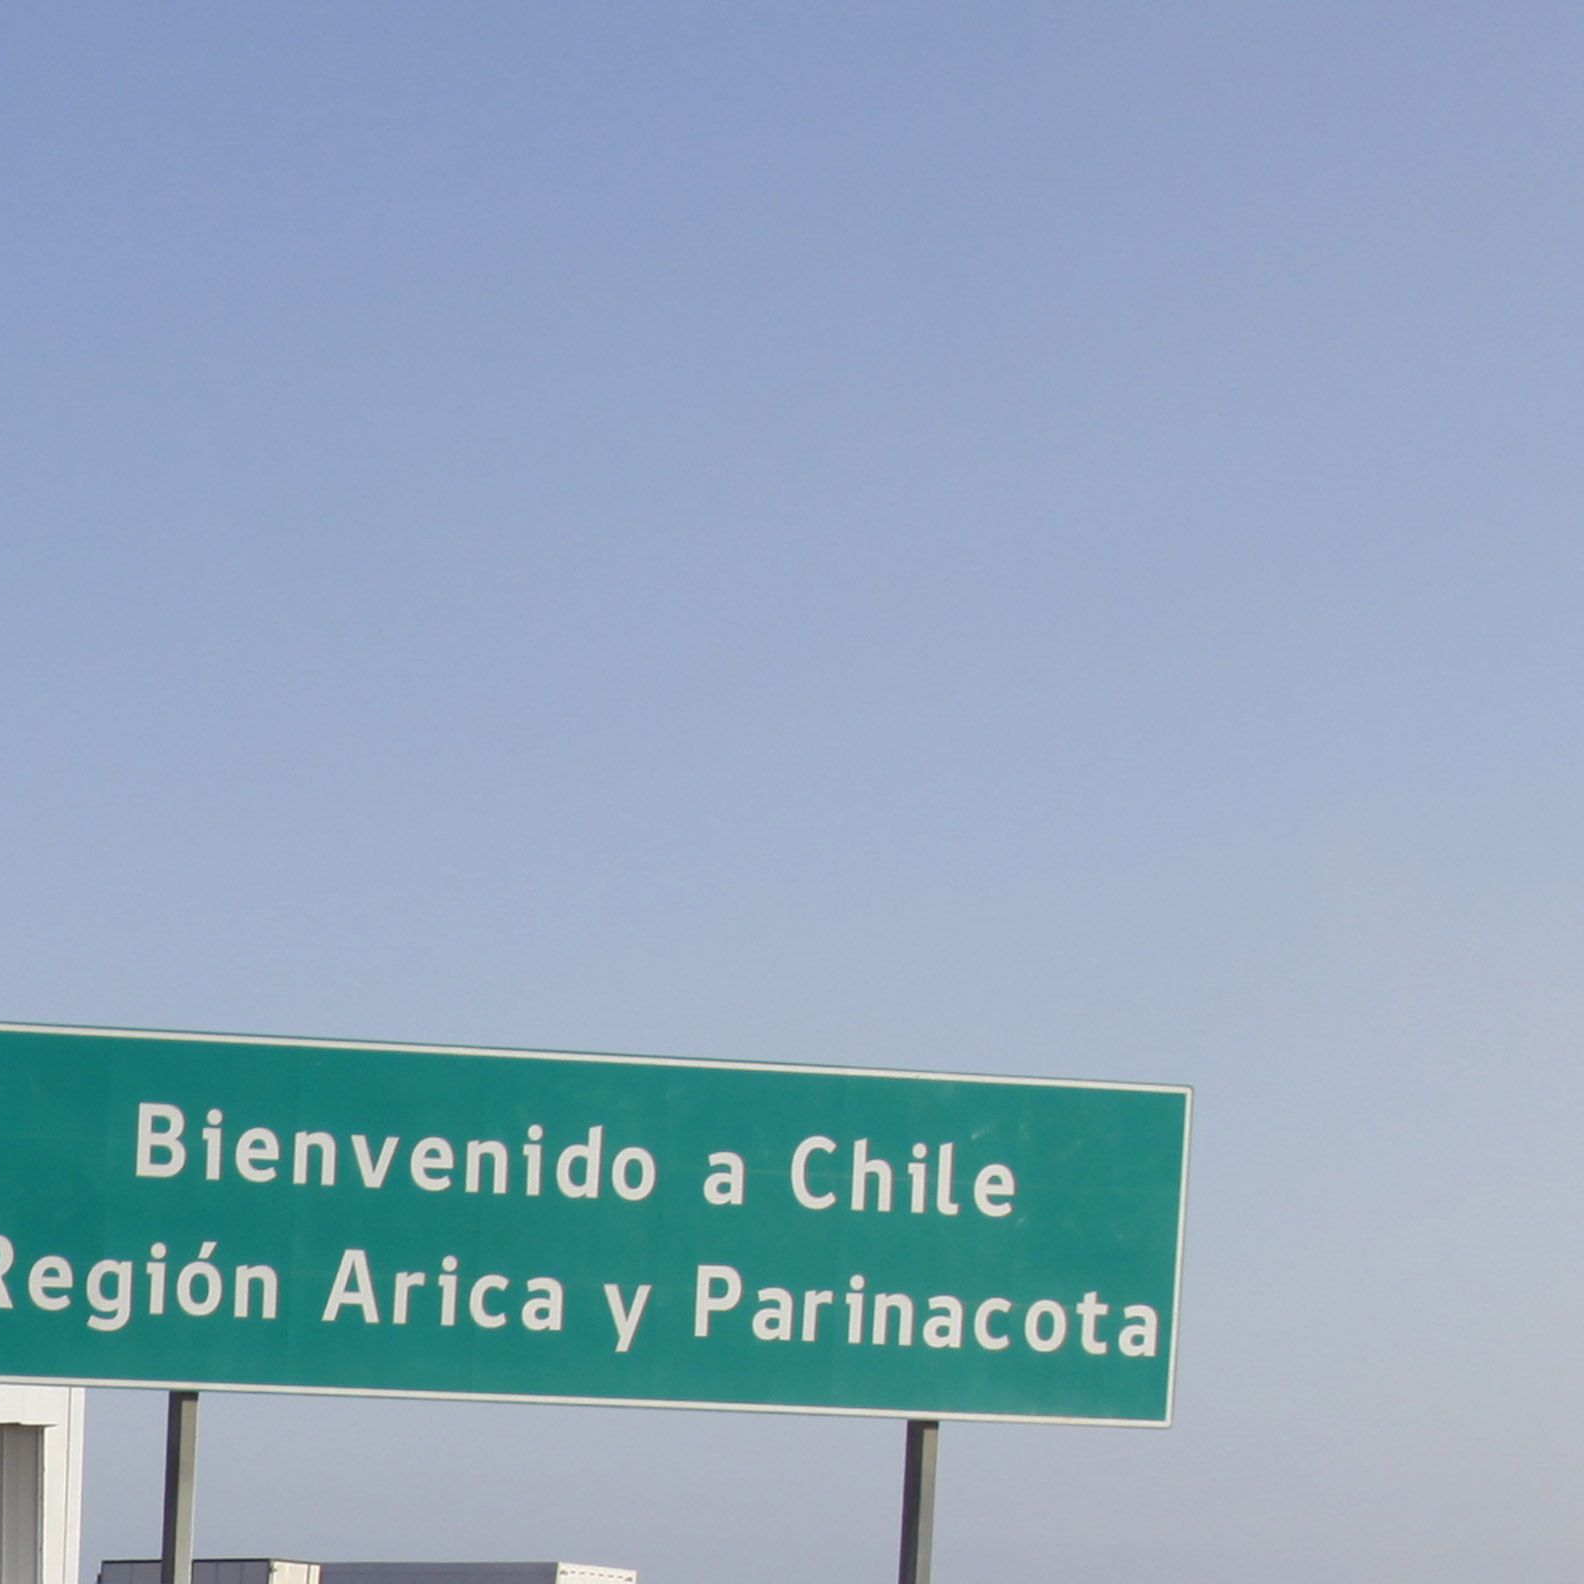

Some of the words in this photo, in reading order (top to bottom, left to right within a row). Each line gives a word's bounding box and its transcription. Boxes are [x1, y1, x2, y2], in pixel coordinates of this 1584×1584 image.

[134, 1101, 656, 1201] Bienvenido
[702, 1150, 745, 1205] a
[789, 1135, 1016, 1217] Chile
[321, 1248, 564, 1332] Arica
[603, 1283, 652, 1353] y
[693, 1264, 1159, 1357] Parinacota
